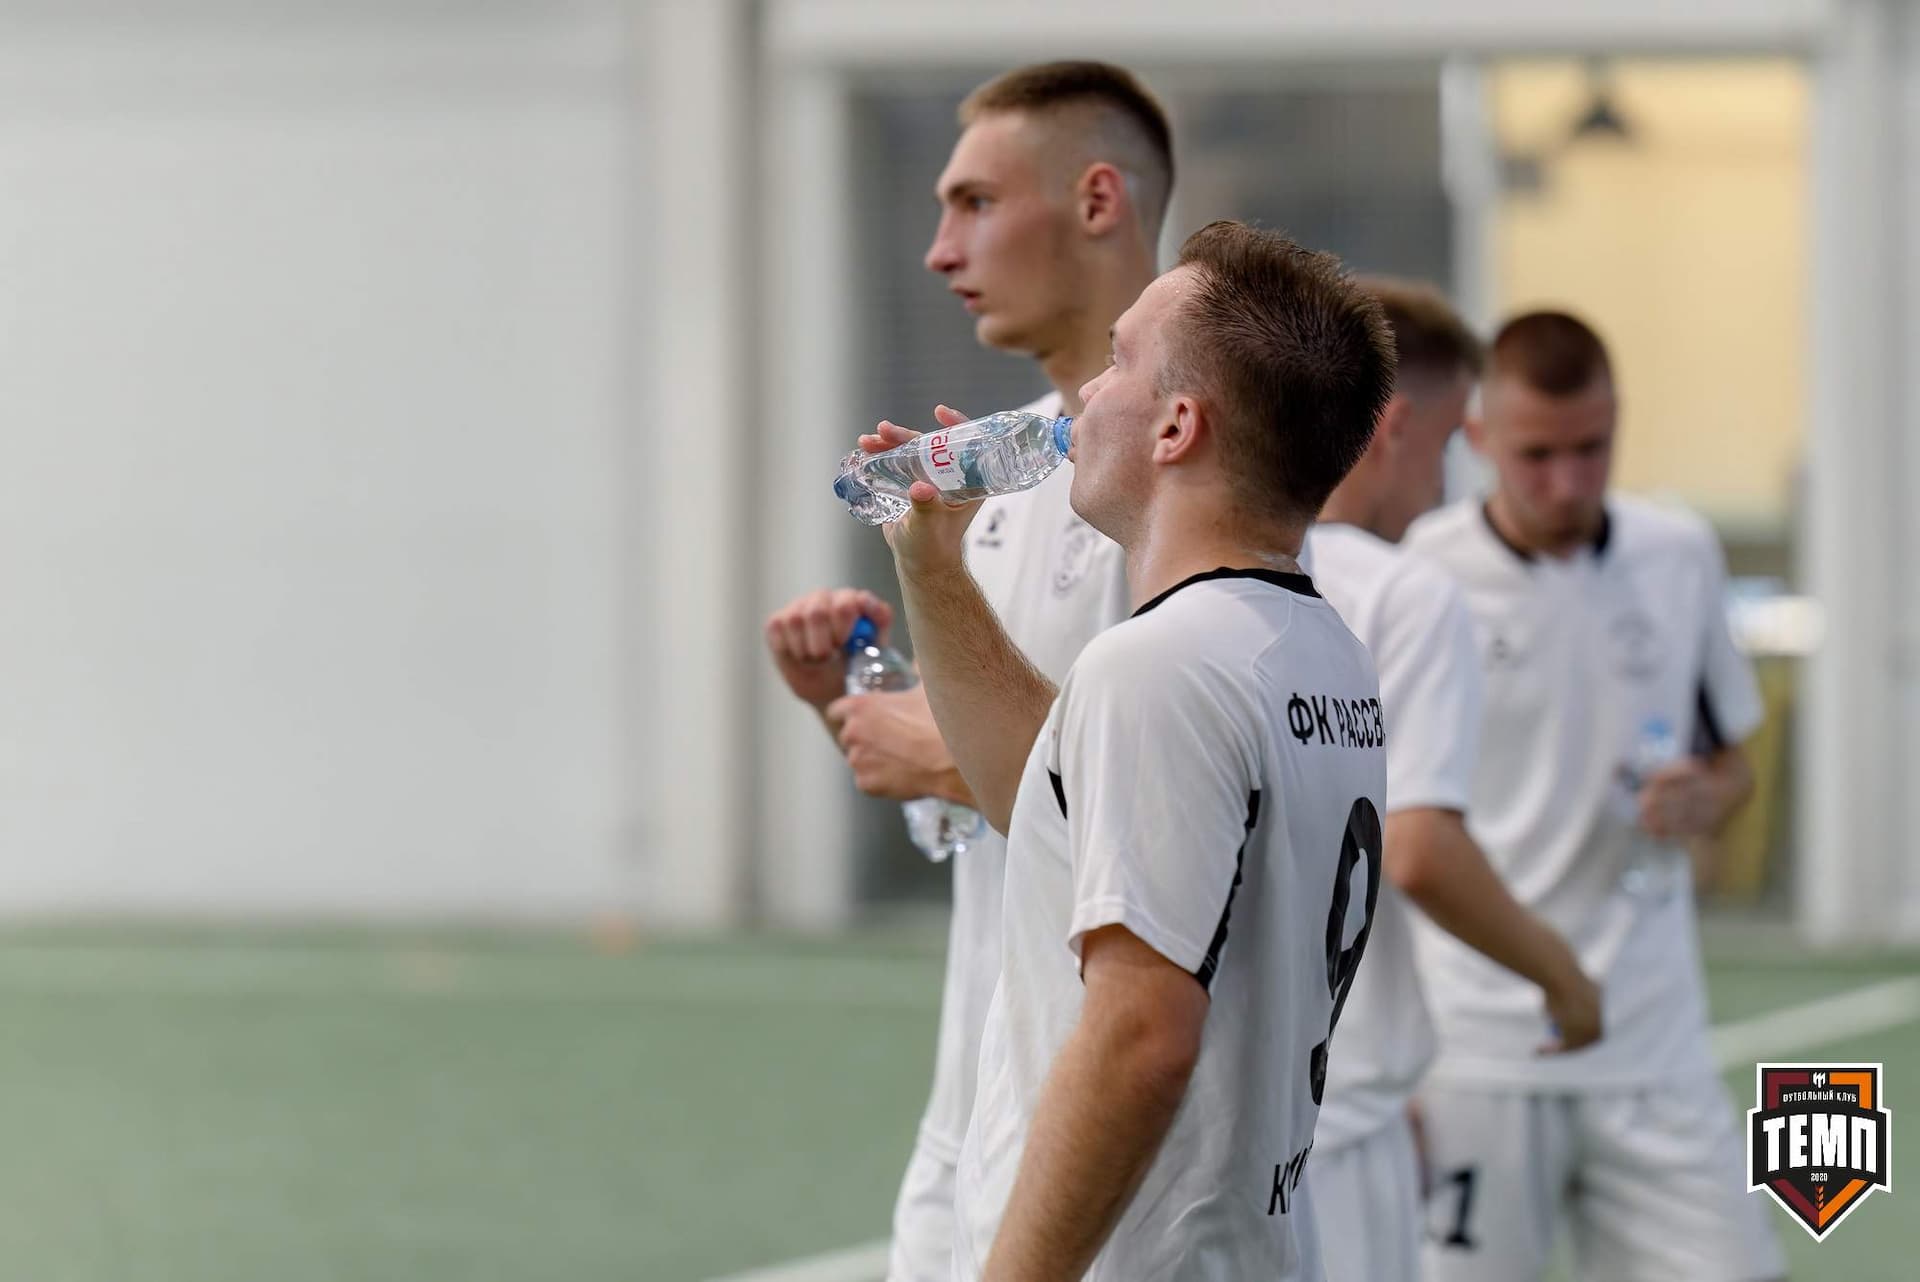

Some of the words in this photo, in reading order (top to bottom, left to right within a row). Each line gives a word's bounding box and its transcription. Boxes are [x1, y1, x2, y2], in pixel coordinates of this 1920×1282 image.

[1287, 692, 1335, 745] ФК
[1332, 697, 1385, 748] РАССВ
[1310, 797, 1382, 1106] 9
